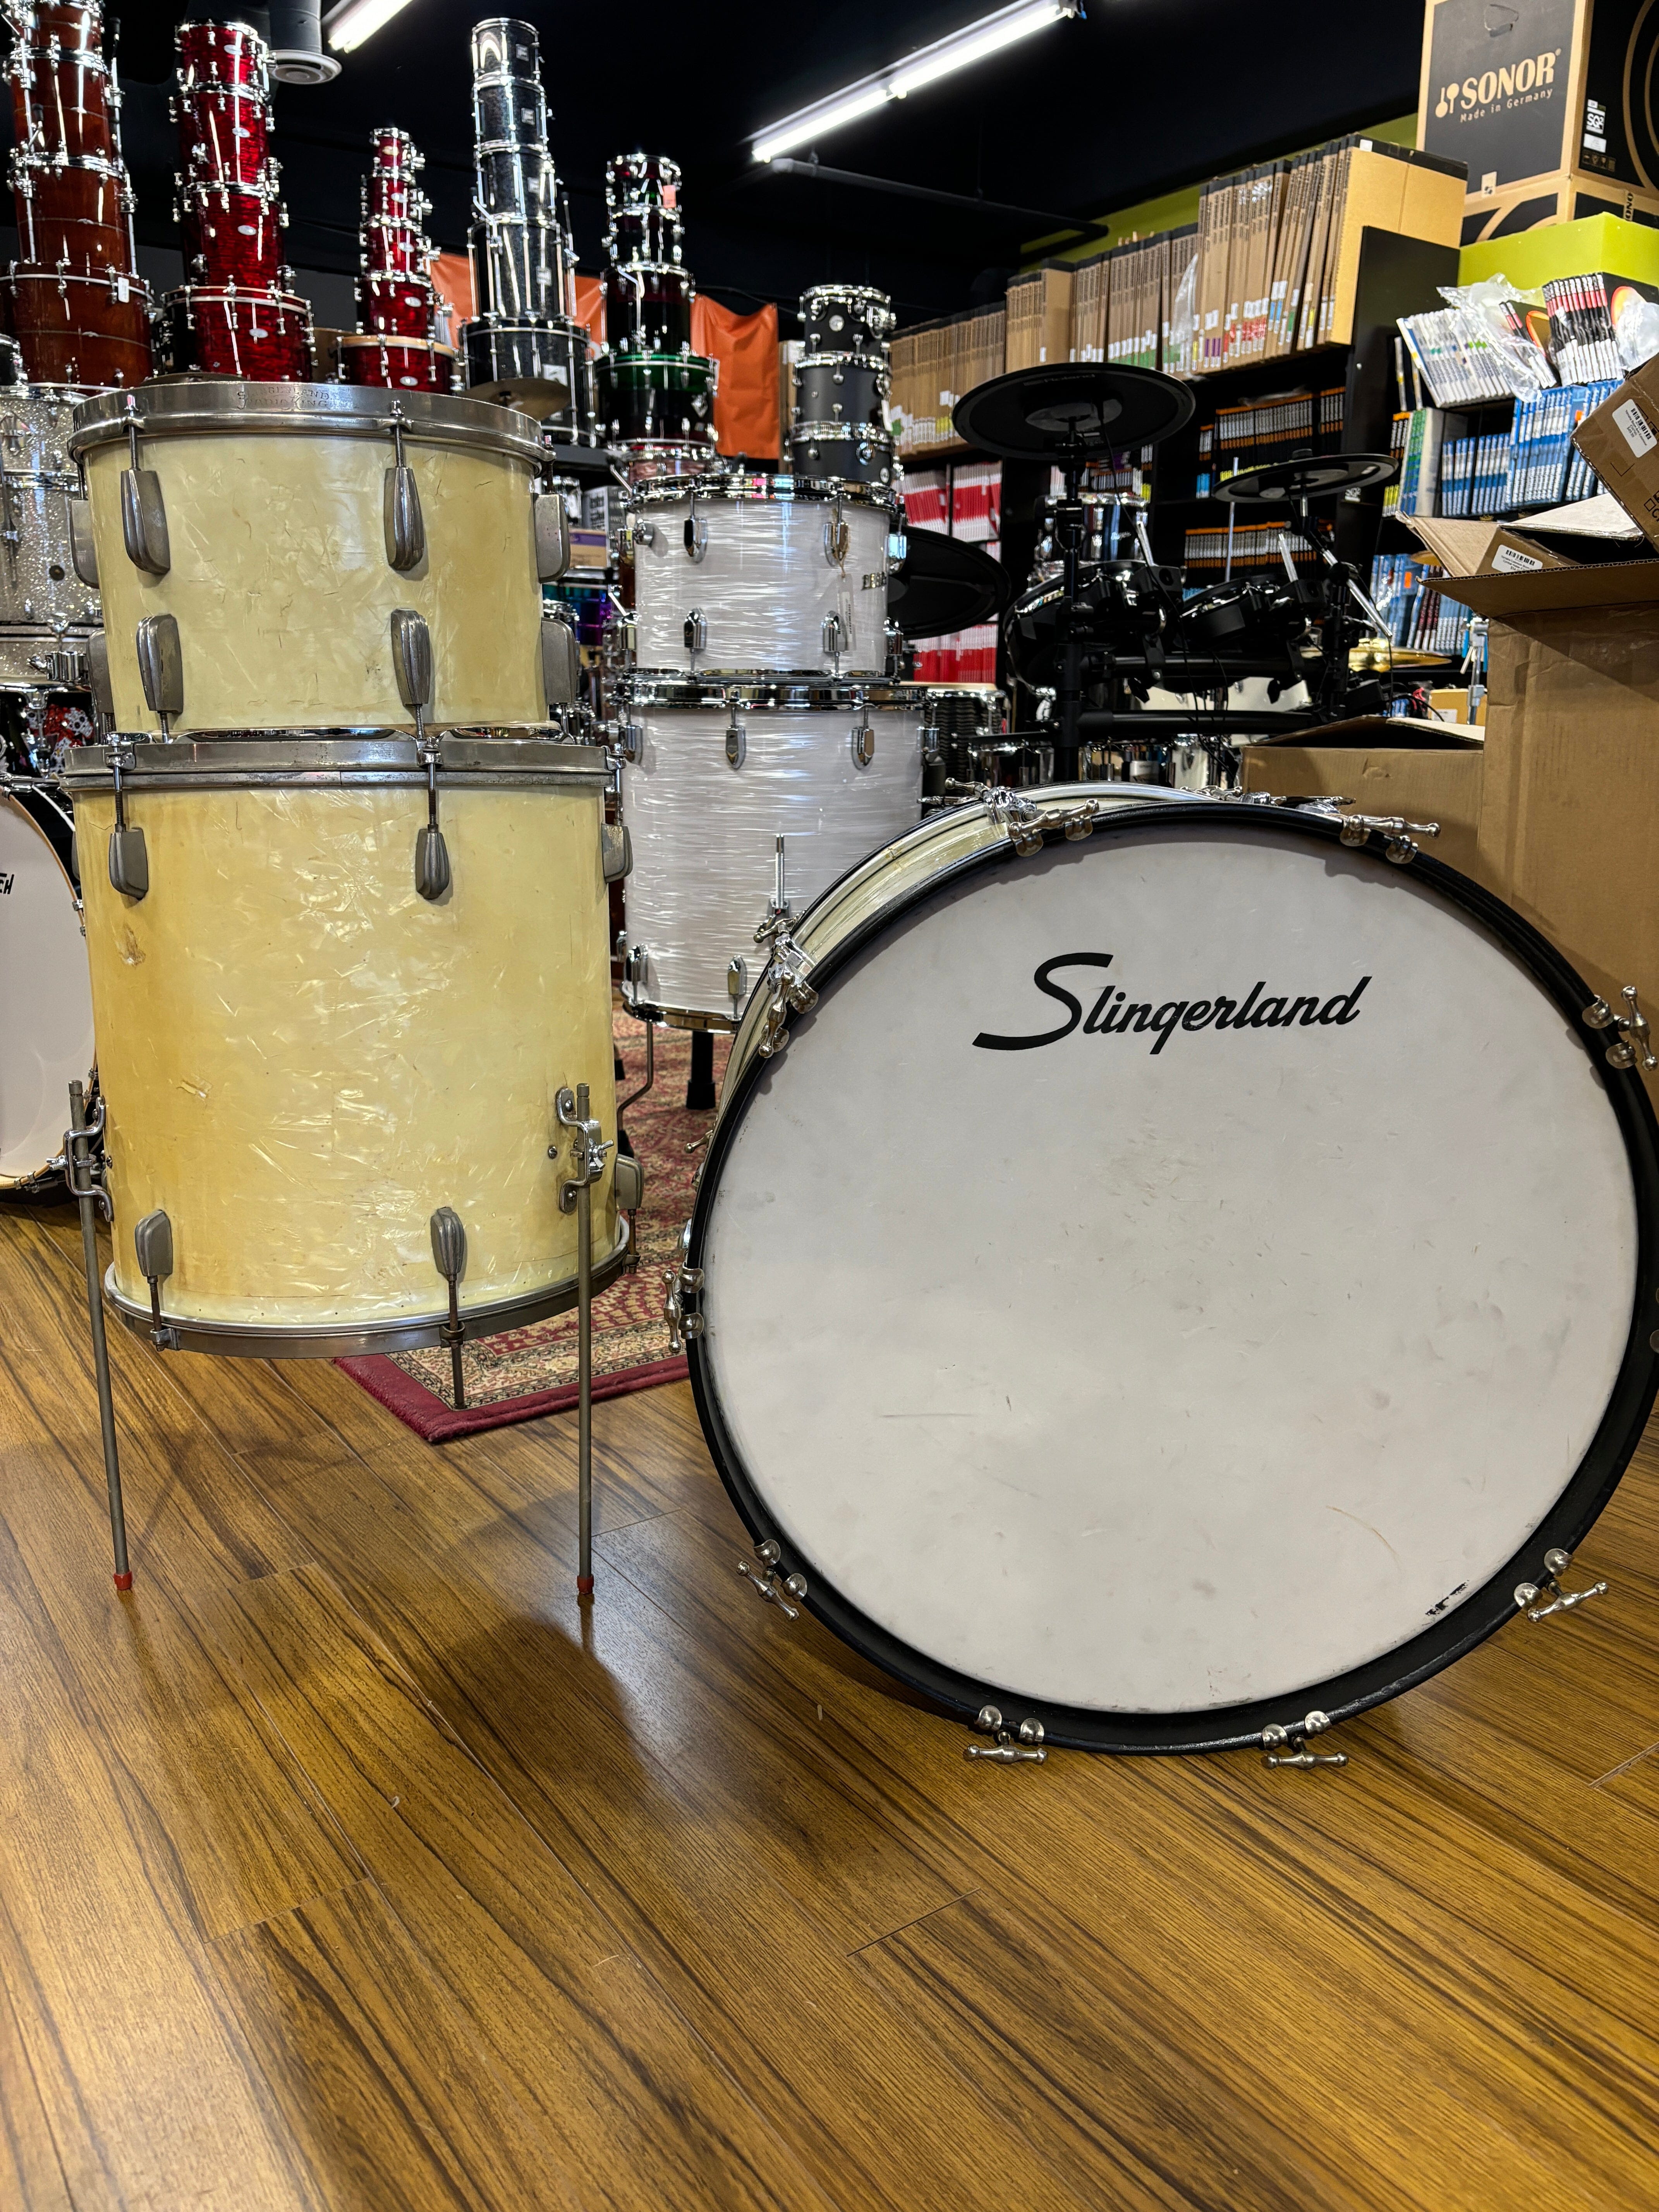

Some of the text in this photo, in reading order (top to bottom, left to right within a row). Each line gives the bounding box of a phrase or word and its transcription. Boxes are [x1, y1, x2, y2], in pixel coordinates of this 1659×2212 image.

[1460, 52, 1556, 110] SONOR
[1460, 88, 1553, 123] Made in Germany
[972, 951, 1373, 1055] Slingerland
